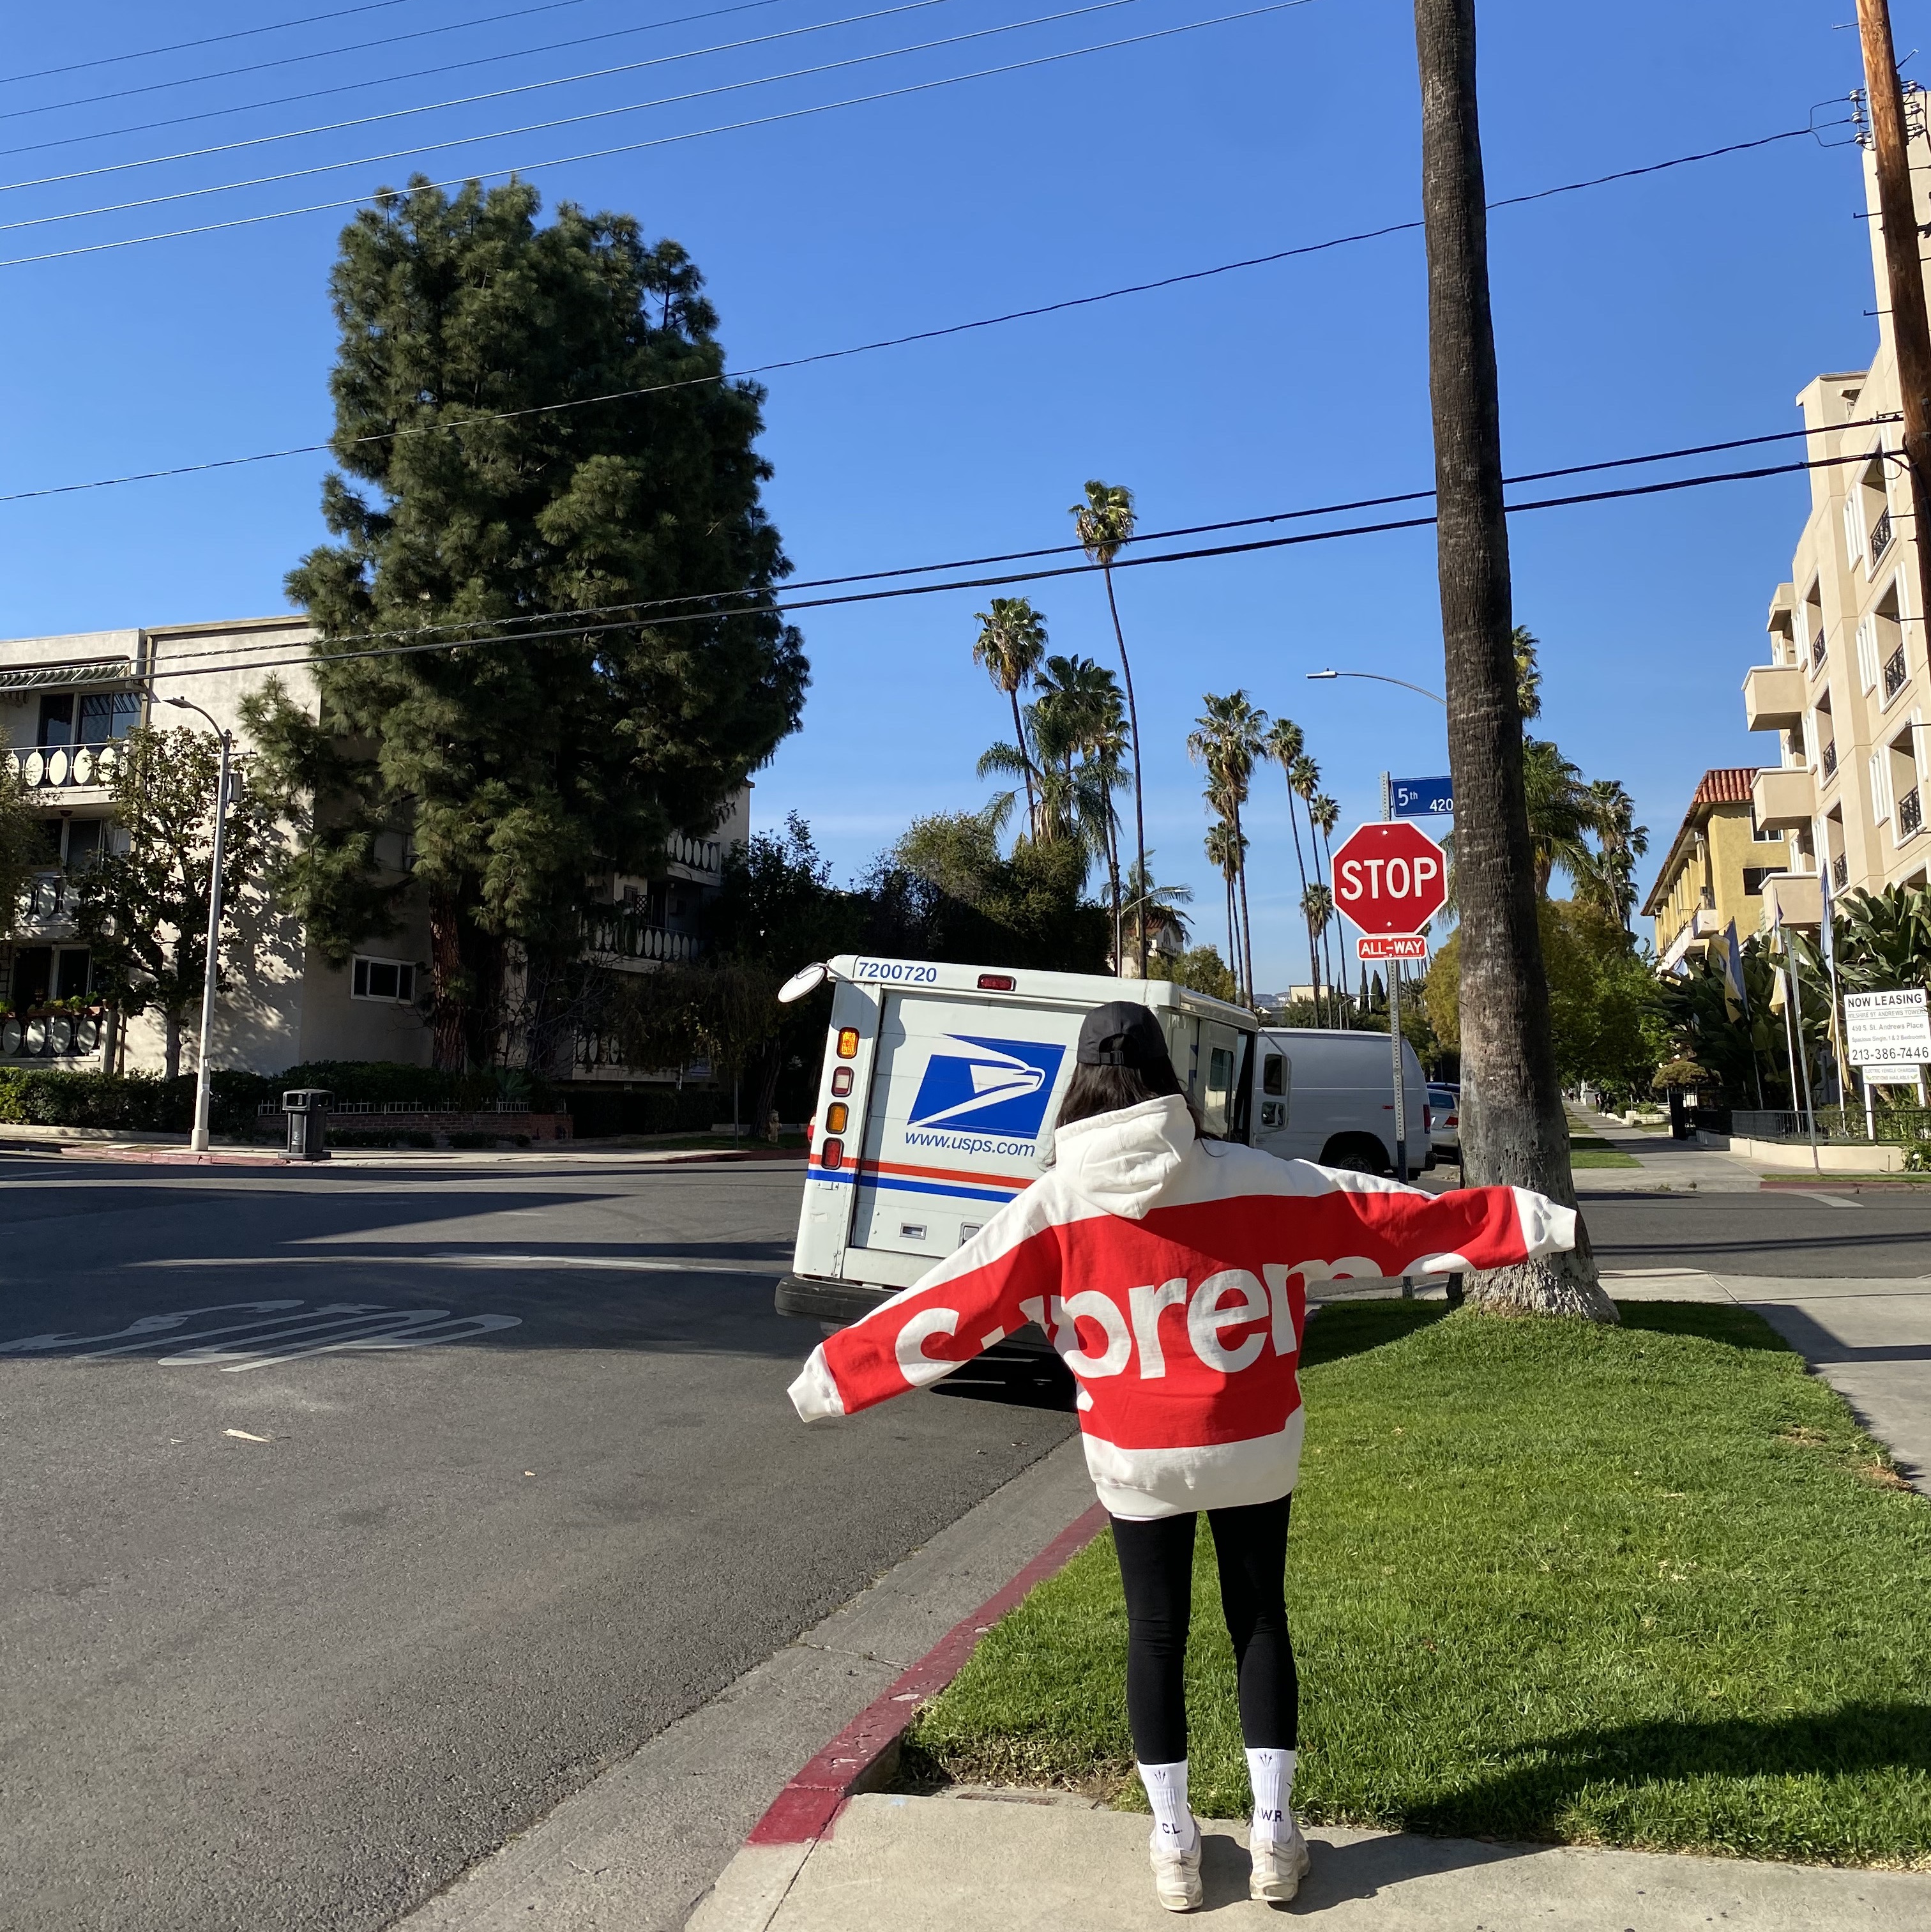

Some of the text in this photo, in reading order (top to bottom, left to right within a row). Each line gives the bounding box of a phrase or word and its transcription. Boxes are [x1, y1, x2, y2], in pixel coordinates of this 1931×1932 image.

[1398, 788, 1418, 807] 5th
[1340, 856, 1437, 901] STOP
[1361, 940, 1423, 955] ALL-WAY
[859, 961, 937, 983] 7200720
[1848, 993, 1922, 1008] NOW LEASING
[1852, 1046, 1929, 1061] 213-386-7446
[905, 1131, 1035, 1157] www.usps.com
